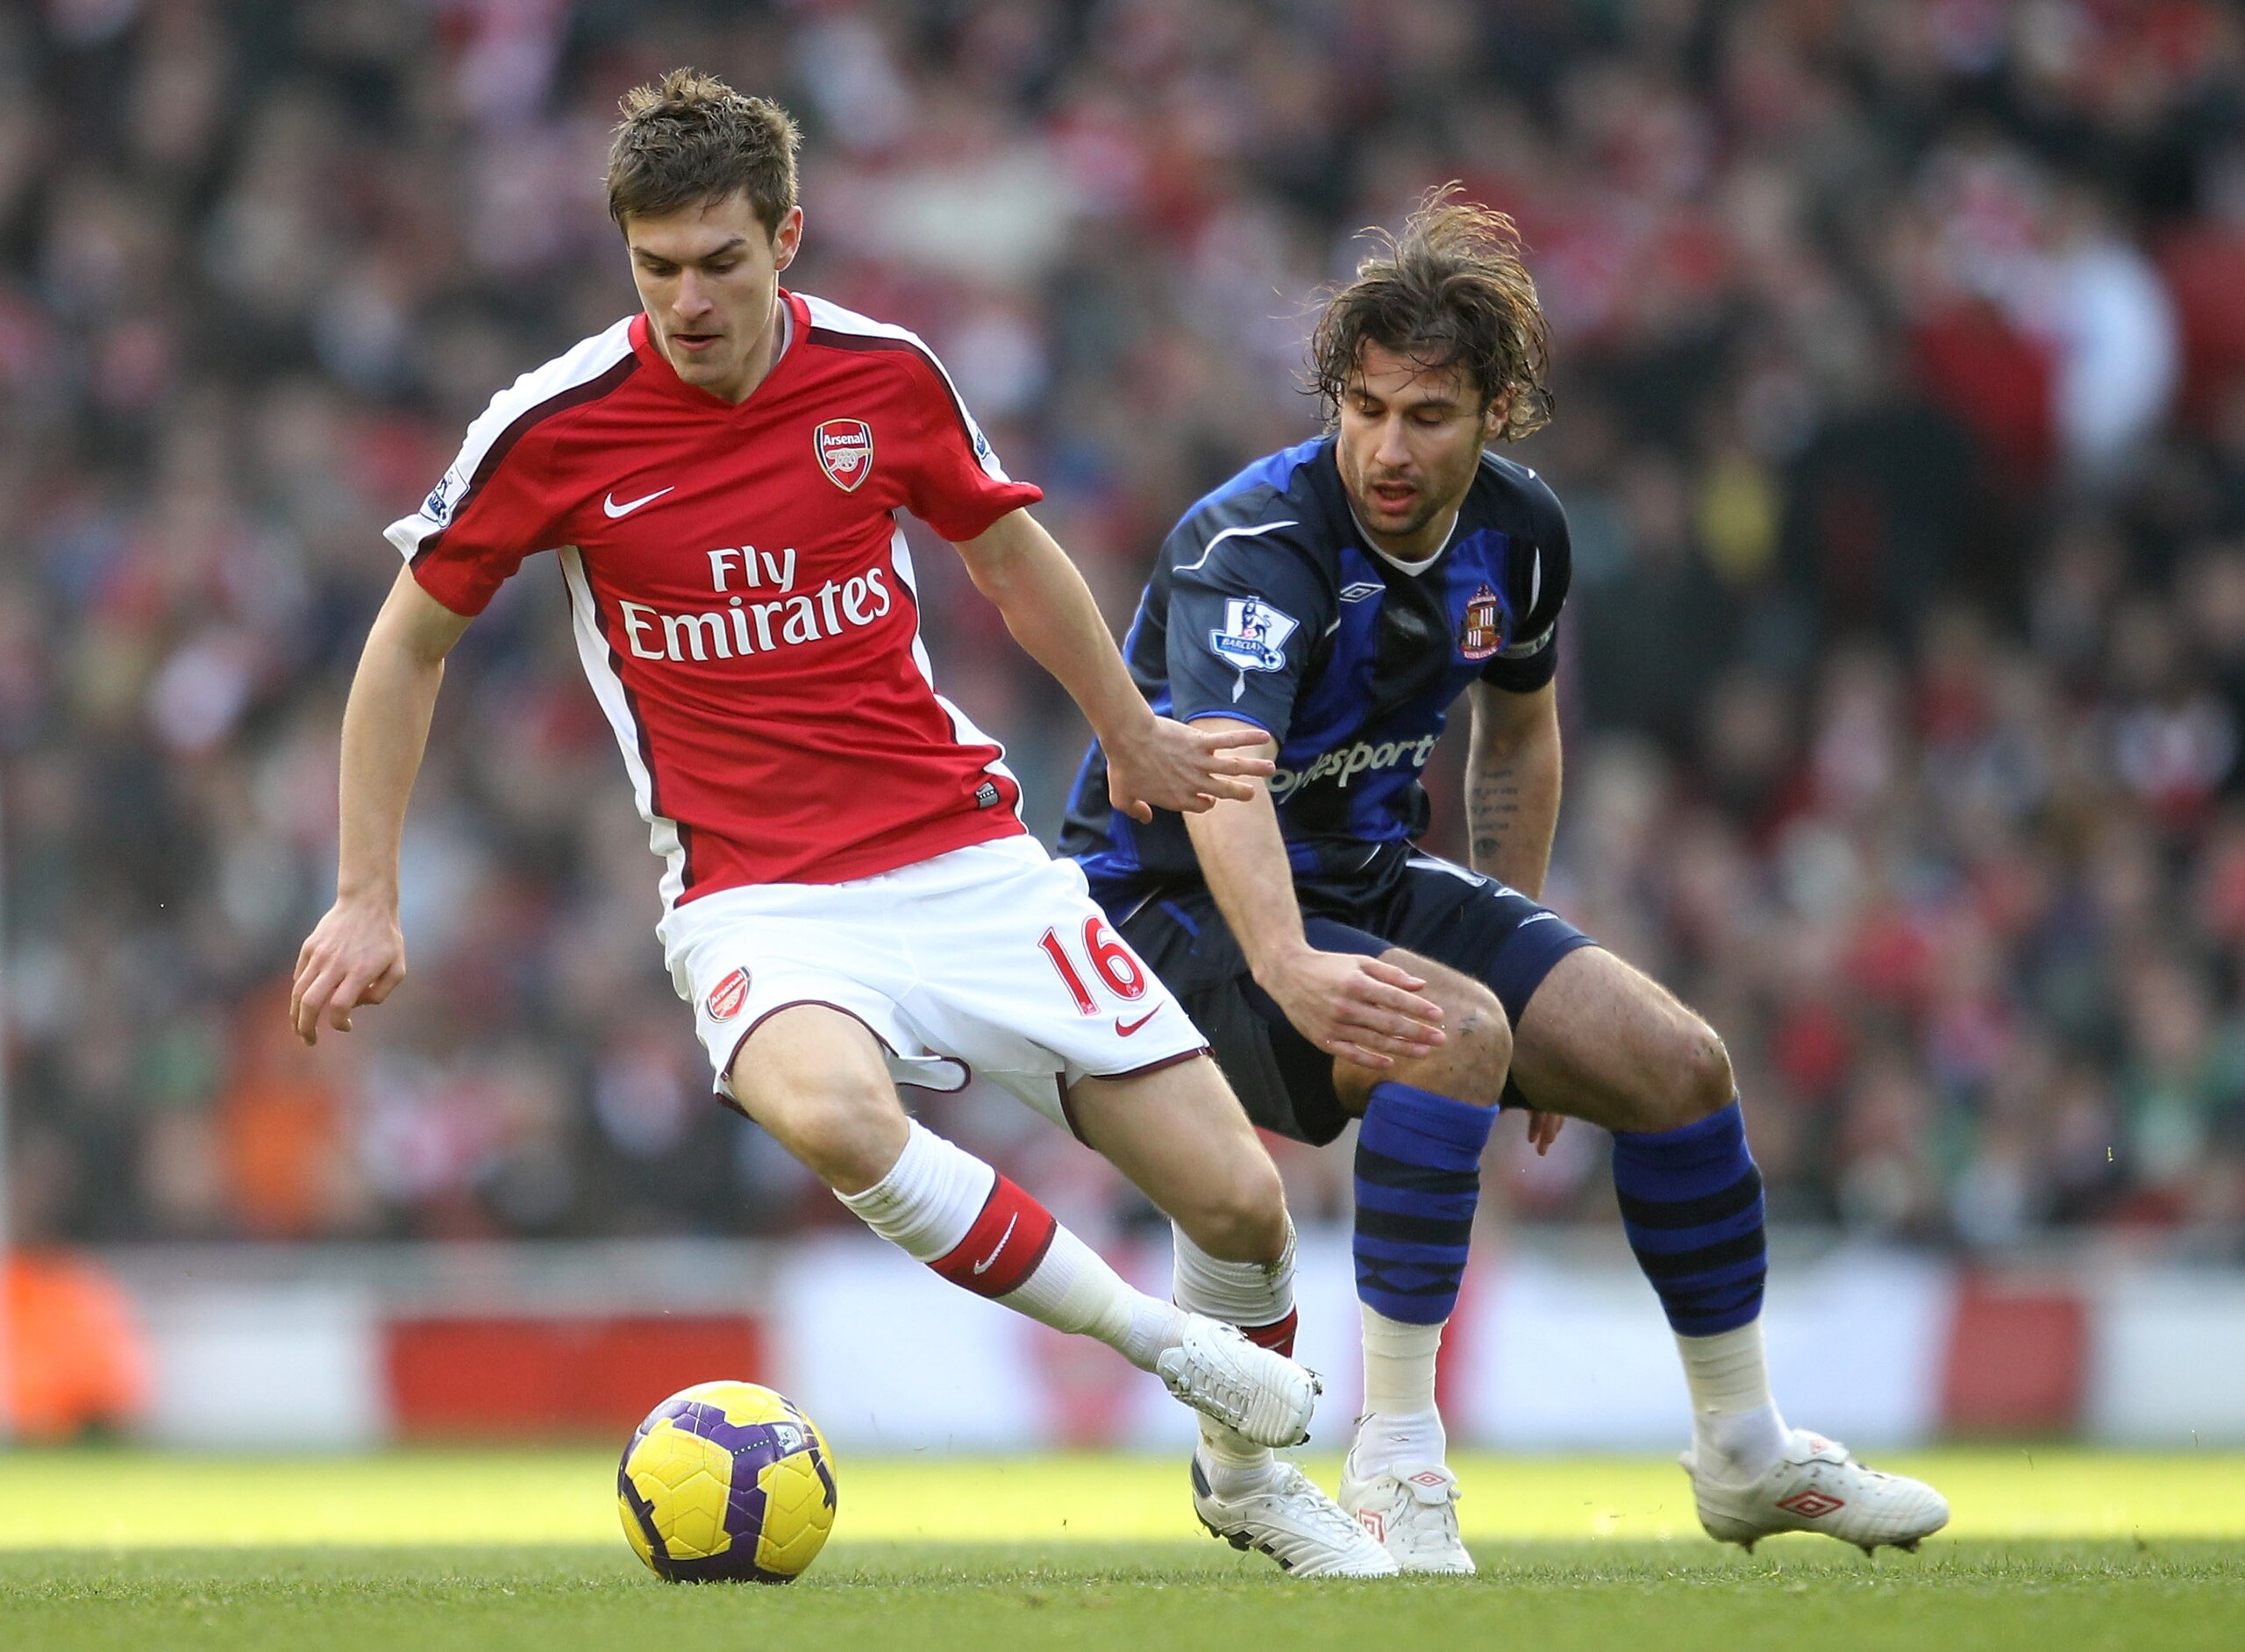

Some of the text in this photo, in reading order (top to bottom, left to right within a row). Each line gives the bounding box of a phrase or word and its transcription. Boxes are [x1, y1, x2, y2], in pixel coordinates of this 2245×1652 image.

[823, 432, 865, 446] Arsenal
[707, 545, 796, 594] Fly
[618, 567, 891, 662] Emirates
[1266, 734, 1440, 806] oylesport
[711, 973, 744, 1007] Arsenal
[1037, 915, 1148, 1016] 16
